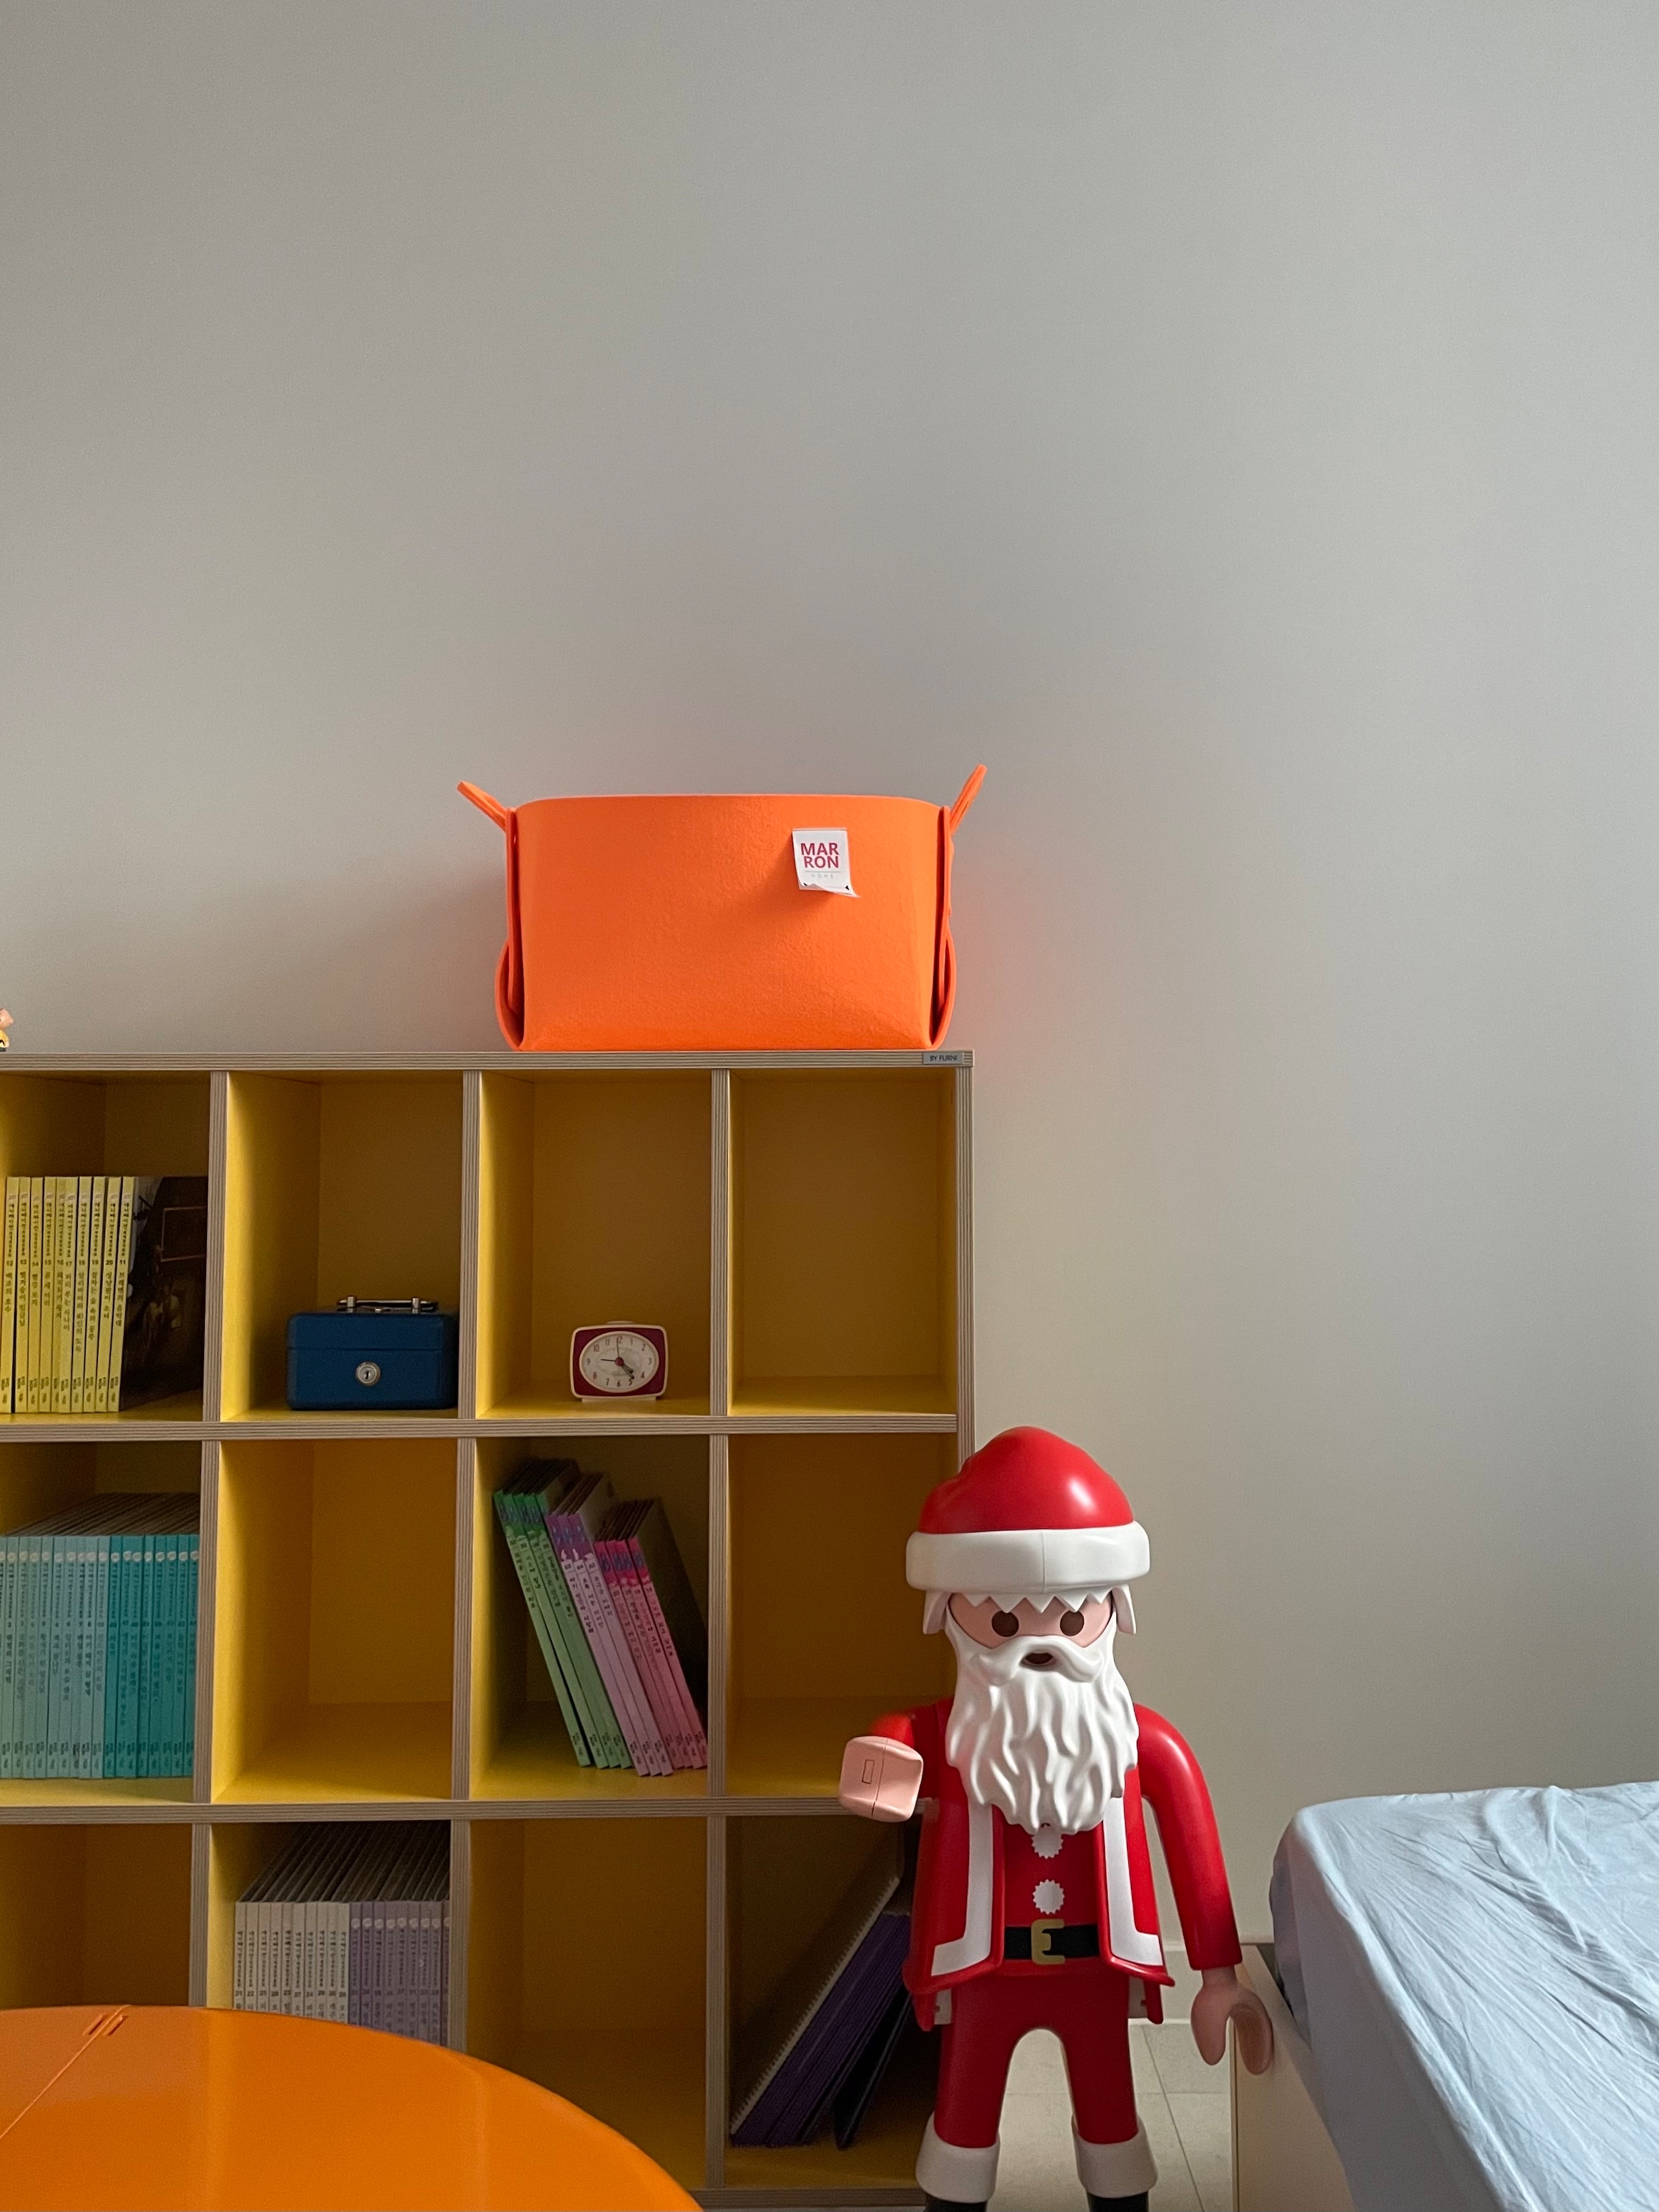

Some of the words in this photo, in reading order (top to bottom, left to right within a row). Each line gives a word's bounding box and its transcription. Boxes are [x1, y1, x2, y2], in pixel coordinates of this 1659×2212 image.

[800, 842, 839, 855] MAR
[804, 856, 839, 868] RON
[594, 1344, 600, 1352] 10
